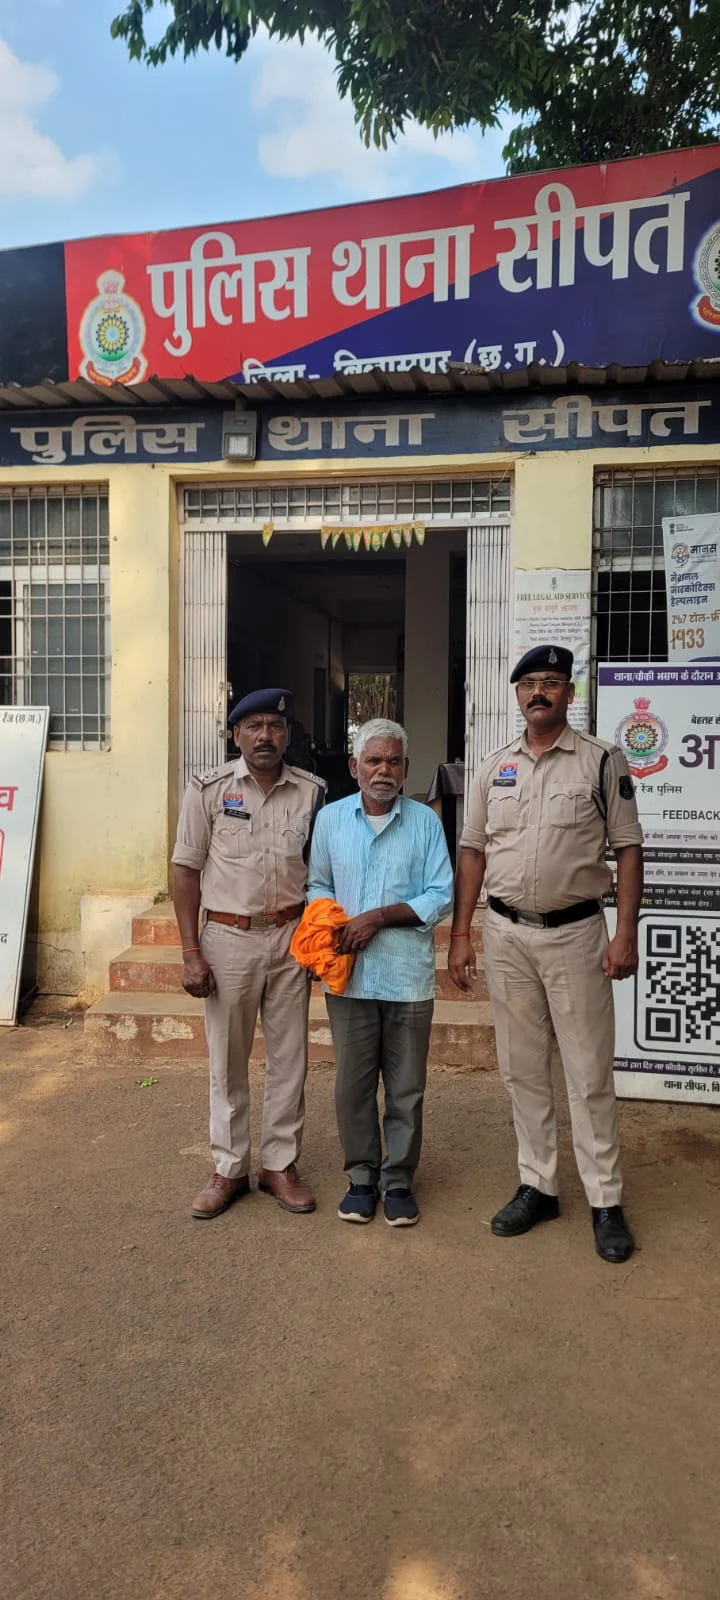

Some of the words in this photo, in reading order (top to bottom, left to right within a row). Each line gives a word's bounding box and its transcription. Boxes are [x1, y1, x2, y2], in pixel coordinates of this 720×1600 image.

[147, 231, 311, 357] पुलिस
[331, 224, 474, 311] थाना
[494, 182, 691, 294] सीपत
[333, 349, 452, 376] बिलासपर
[9, 415, 206, 464] पुलिस
[267, 412, 435, 453] थाना
[502, 394, 712, 444] सीपत
[690, 543, 717, 554] मानस
[670, 581, 716, 595] नारकोटिक्स
[516, 593, 531, 602] FREE
[533, 592, 553, 601] LEGAL
[670, 595, 708, 607] हेल्पलाइन
[671, 627, 705, 650] 1933
[680, 669, 689, 681] के
[690, 669, 714, 682] दौरान
[691, 713, 713, 725] बेहतर
[640, 782, 653, 794] रेंज
[657, 781, 683, 796] पुलिस
[662, 809, 720, 820] FEEDBACK
[664, 1080, 682, 1089] थाना
